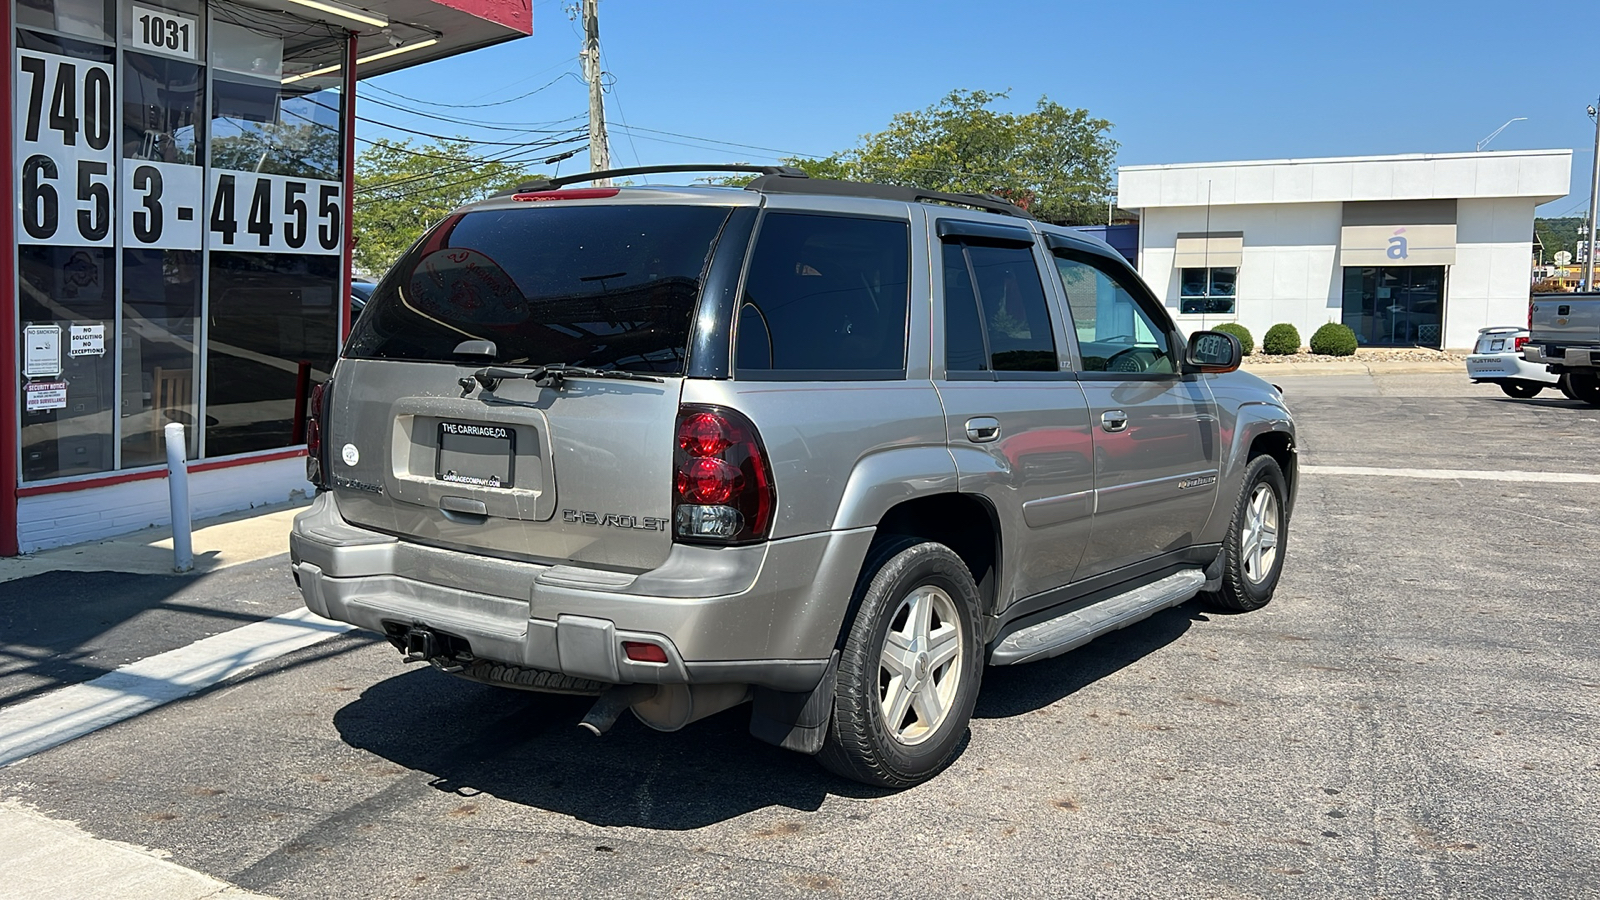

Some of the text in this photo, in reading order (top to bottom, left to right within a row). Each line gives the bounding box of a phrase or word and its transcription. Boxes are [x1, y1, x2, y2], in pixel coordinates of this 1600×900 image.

[140, 15, 189, 52] 1031
[21, 55, 111, 150] 740
[1386, 227, 1408, 260] á
[50, 382, 65, 390] NOTICE
[40, 397, 66, 405] SURVEILLANCE
[442, 423, 458, 434] THE
[457, 424, 496, 436] CARRIAGE
[442, 474, 501, 487] CARRIAGECOMPANY.COM
[562, 509, 669, 531] CHEVROLET
